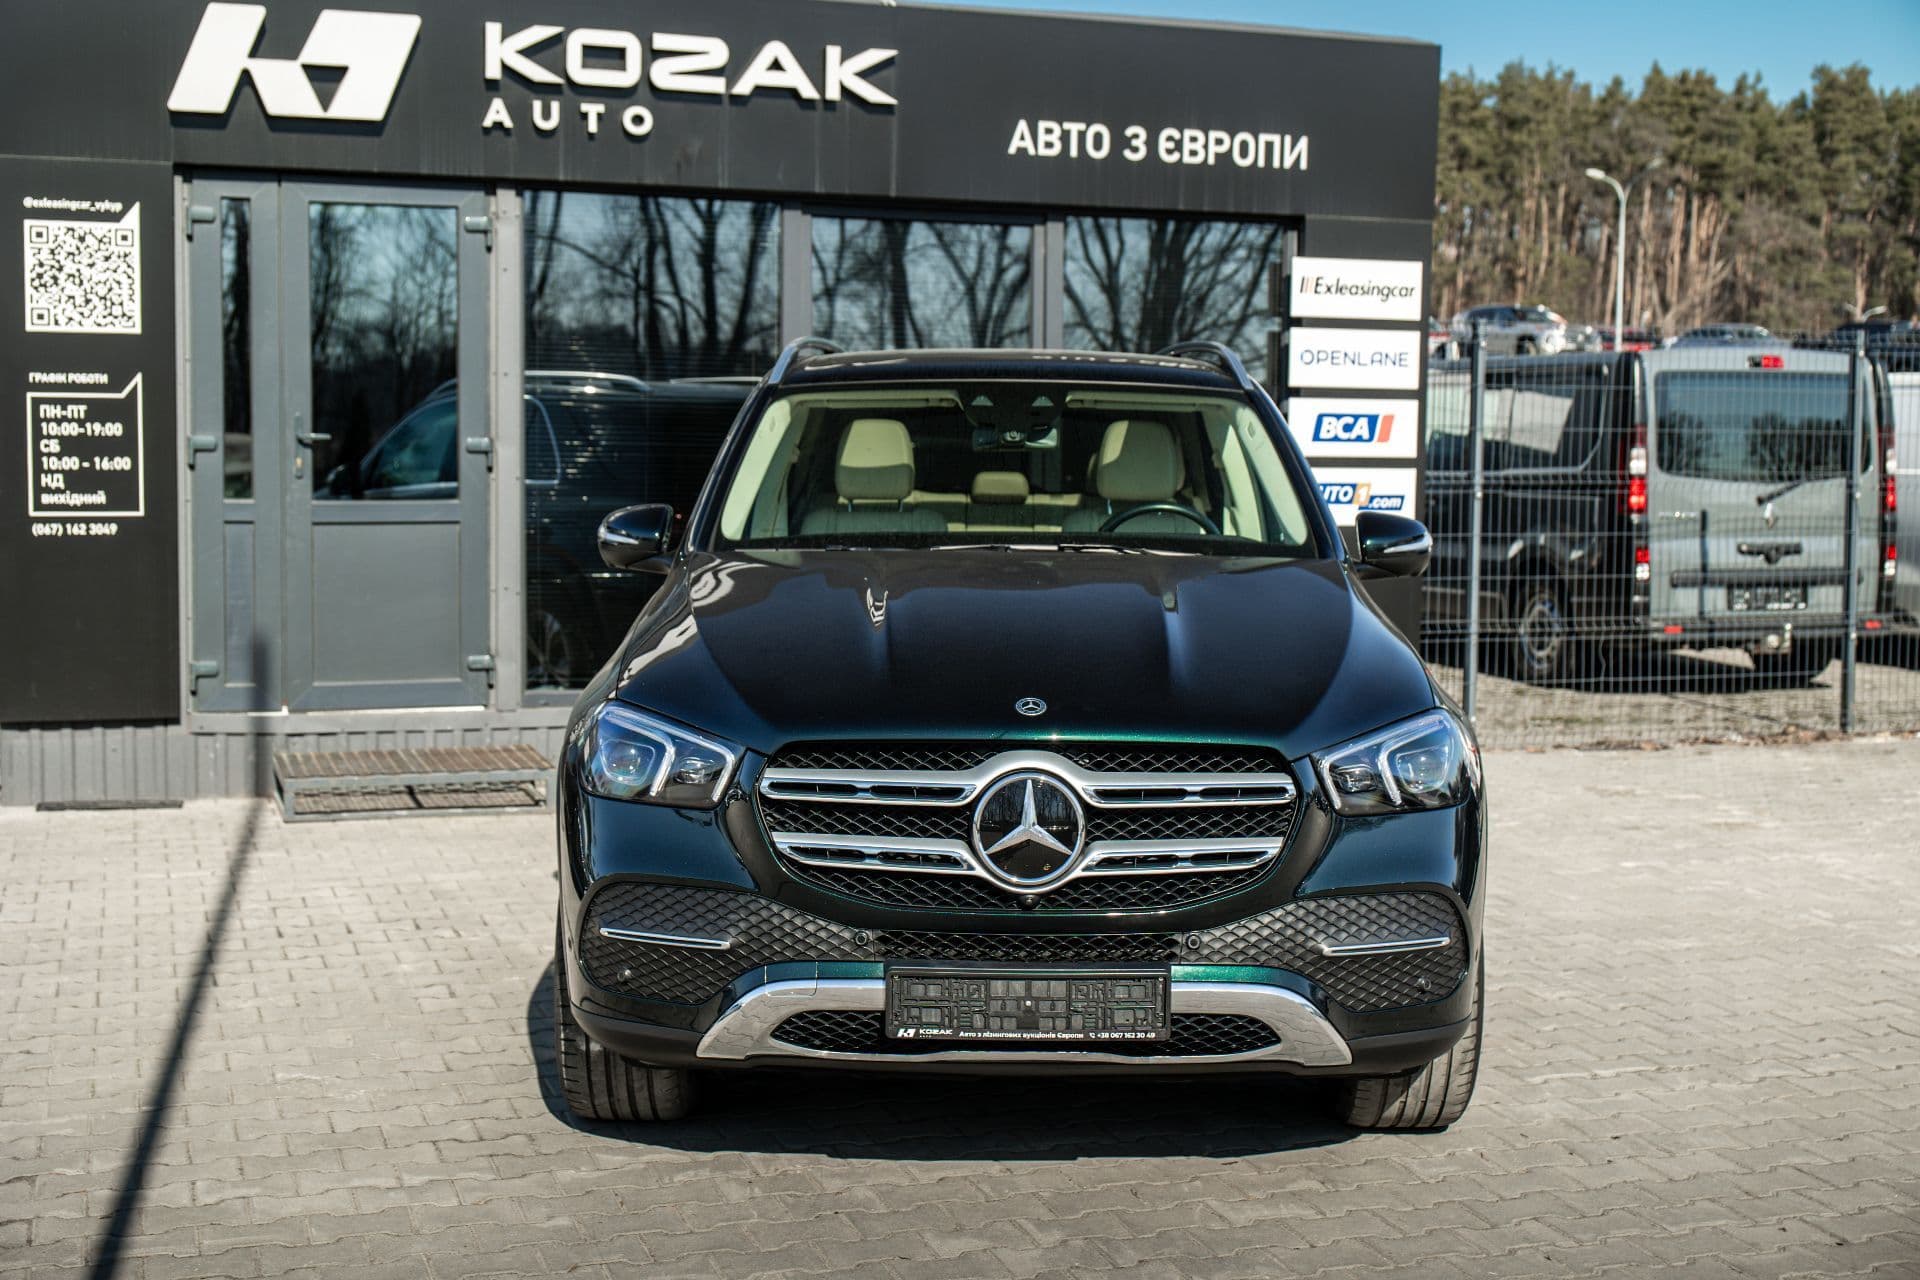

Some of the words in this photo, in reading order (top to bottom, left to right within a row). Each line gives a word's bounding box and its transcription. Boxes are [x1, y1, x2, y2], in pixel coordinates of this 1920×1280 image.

[485, 21, 899, 106] KOZAK
[481, 97, 654, 137] AUTO
[1007, 119, 1111, 160] АВТО
[1158, 127, 1309, 171] ЄВРОПИ
[1314, 276, 1416, 302] Exleasingcar
[1300, 349, 1409, 368] OPENLANE
[68, 373, 108, 384] РОБОТИ
[39, 404, 88, 419] ПН-ПТ
[41, 421, 123, 437] 10:00-19:00
[1318, 415, 1371, 441] BCA
[40, 438, 61, 454] СБ
[41, 455, 80, 471] 10:00
[93, 455, 132, 471] 16:00
[40, 473, 65, 490] НД
[41, 490, 107, 507] вихідний
[31, 522, 64, 537] (067)
[66, 522, 87, 536] 162
[88, 523, 118, 536] 3049
